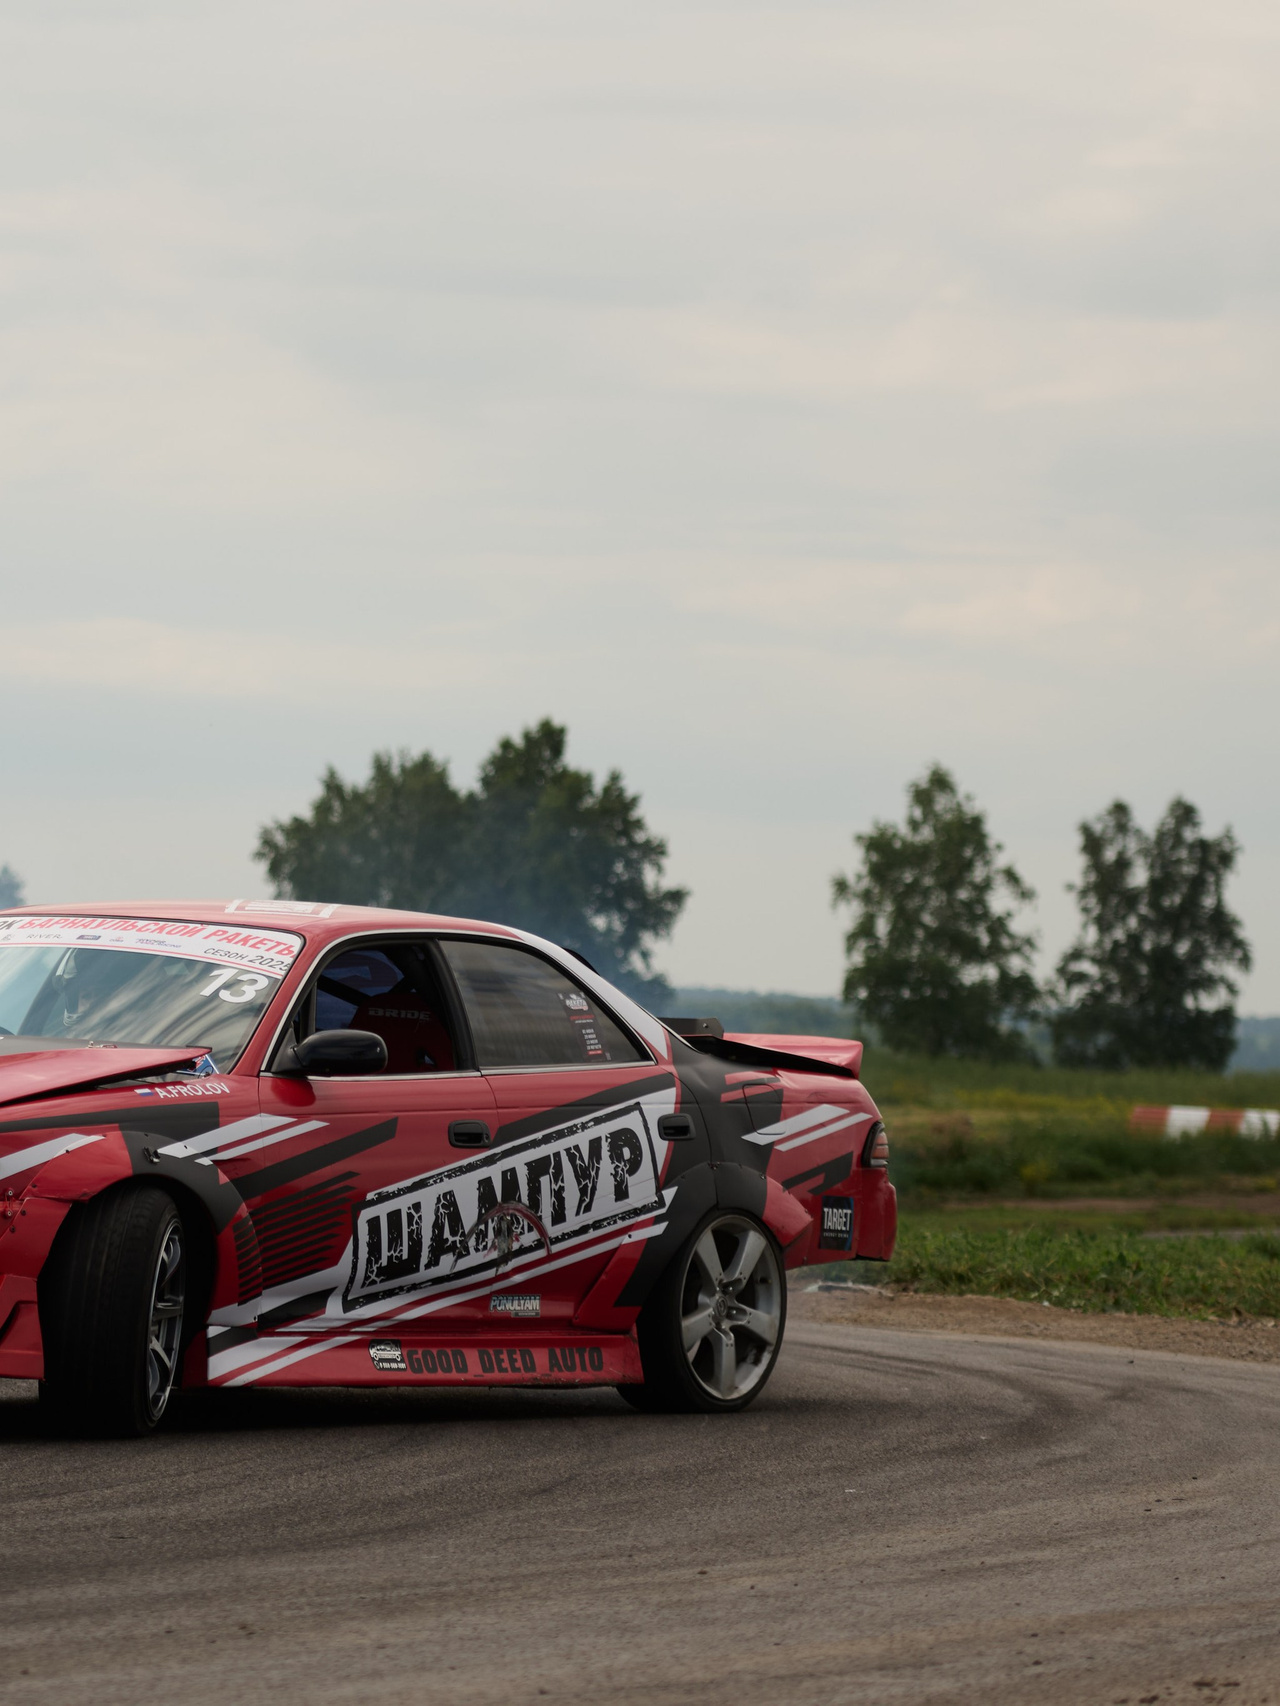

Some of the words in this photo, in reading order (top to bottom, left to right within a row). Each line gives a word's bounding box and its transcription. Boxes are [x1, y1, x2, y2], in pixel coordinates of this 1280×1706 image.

[18, 918, 207, 938] БАРНАУЛЬСКОЙ
[204, 947, 249, 961] СЕЗОН
[248, 954, 291, 972] 2025
[200, 968, 269, 1003] 13
[368, 1007, 431, 1020] BRIDE
[154, 1083, 230, 1098] A.FROLOV
[361, 1127, 644, 1290] ШАМПУР
[823, 1207, 852, 1231] TARGET
[490, 1296, 540, 1311] PONULYAM
